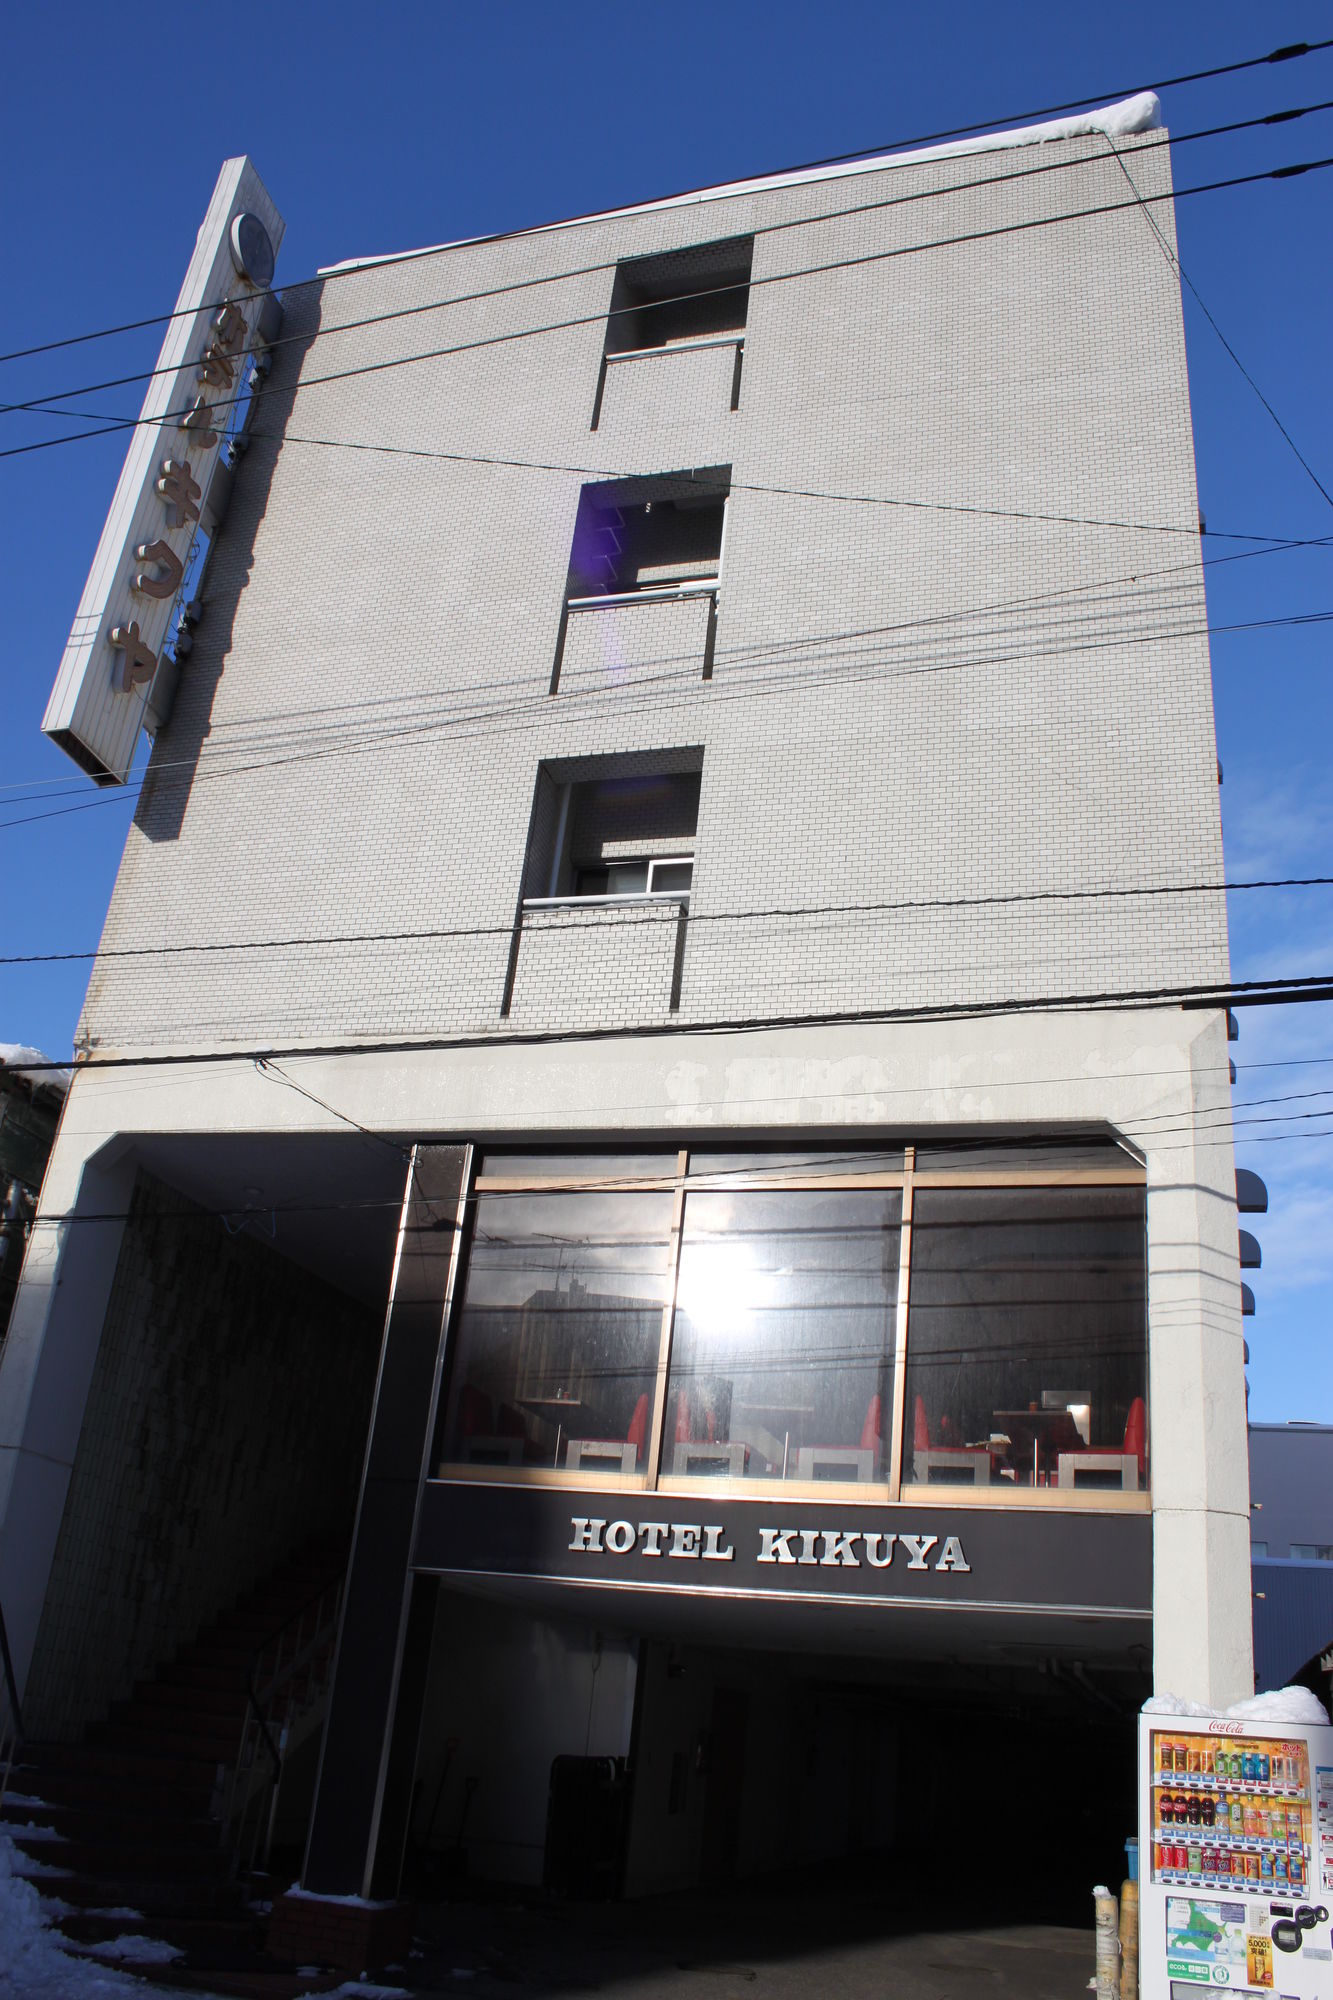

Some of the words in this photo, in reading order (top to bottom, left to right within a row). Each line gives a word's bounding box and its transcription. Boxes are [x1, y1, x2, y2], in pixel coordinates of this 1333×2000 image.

[568, 1517, 735, 1561] HOTEL
[756, 1528, 972, 1572] KIKUYA
[1248, 1939, 1267, 1948] 5,000
